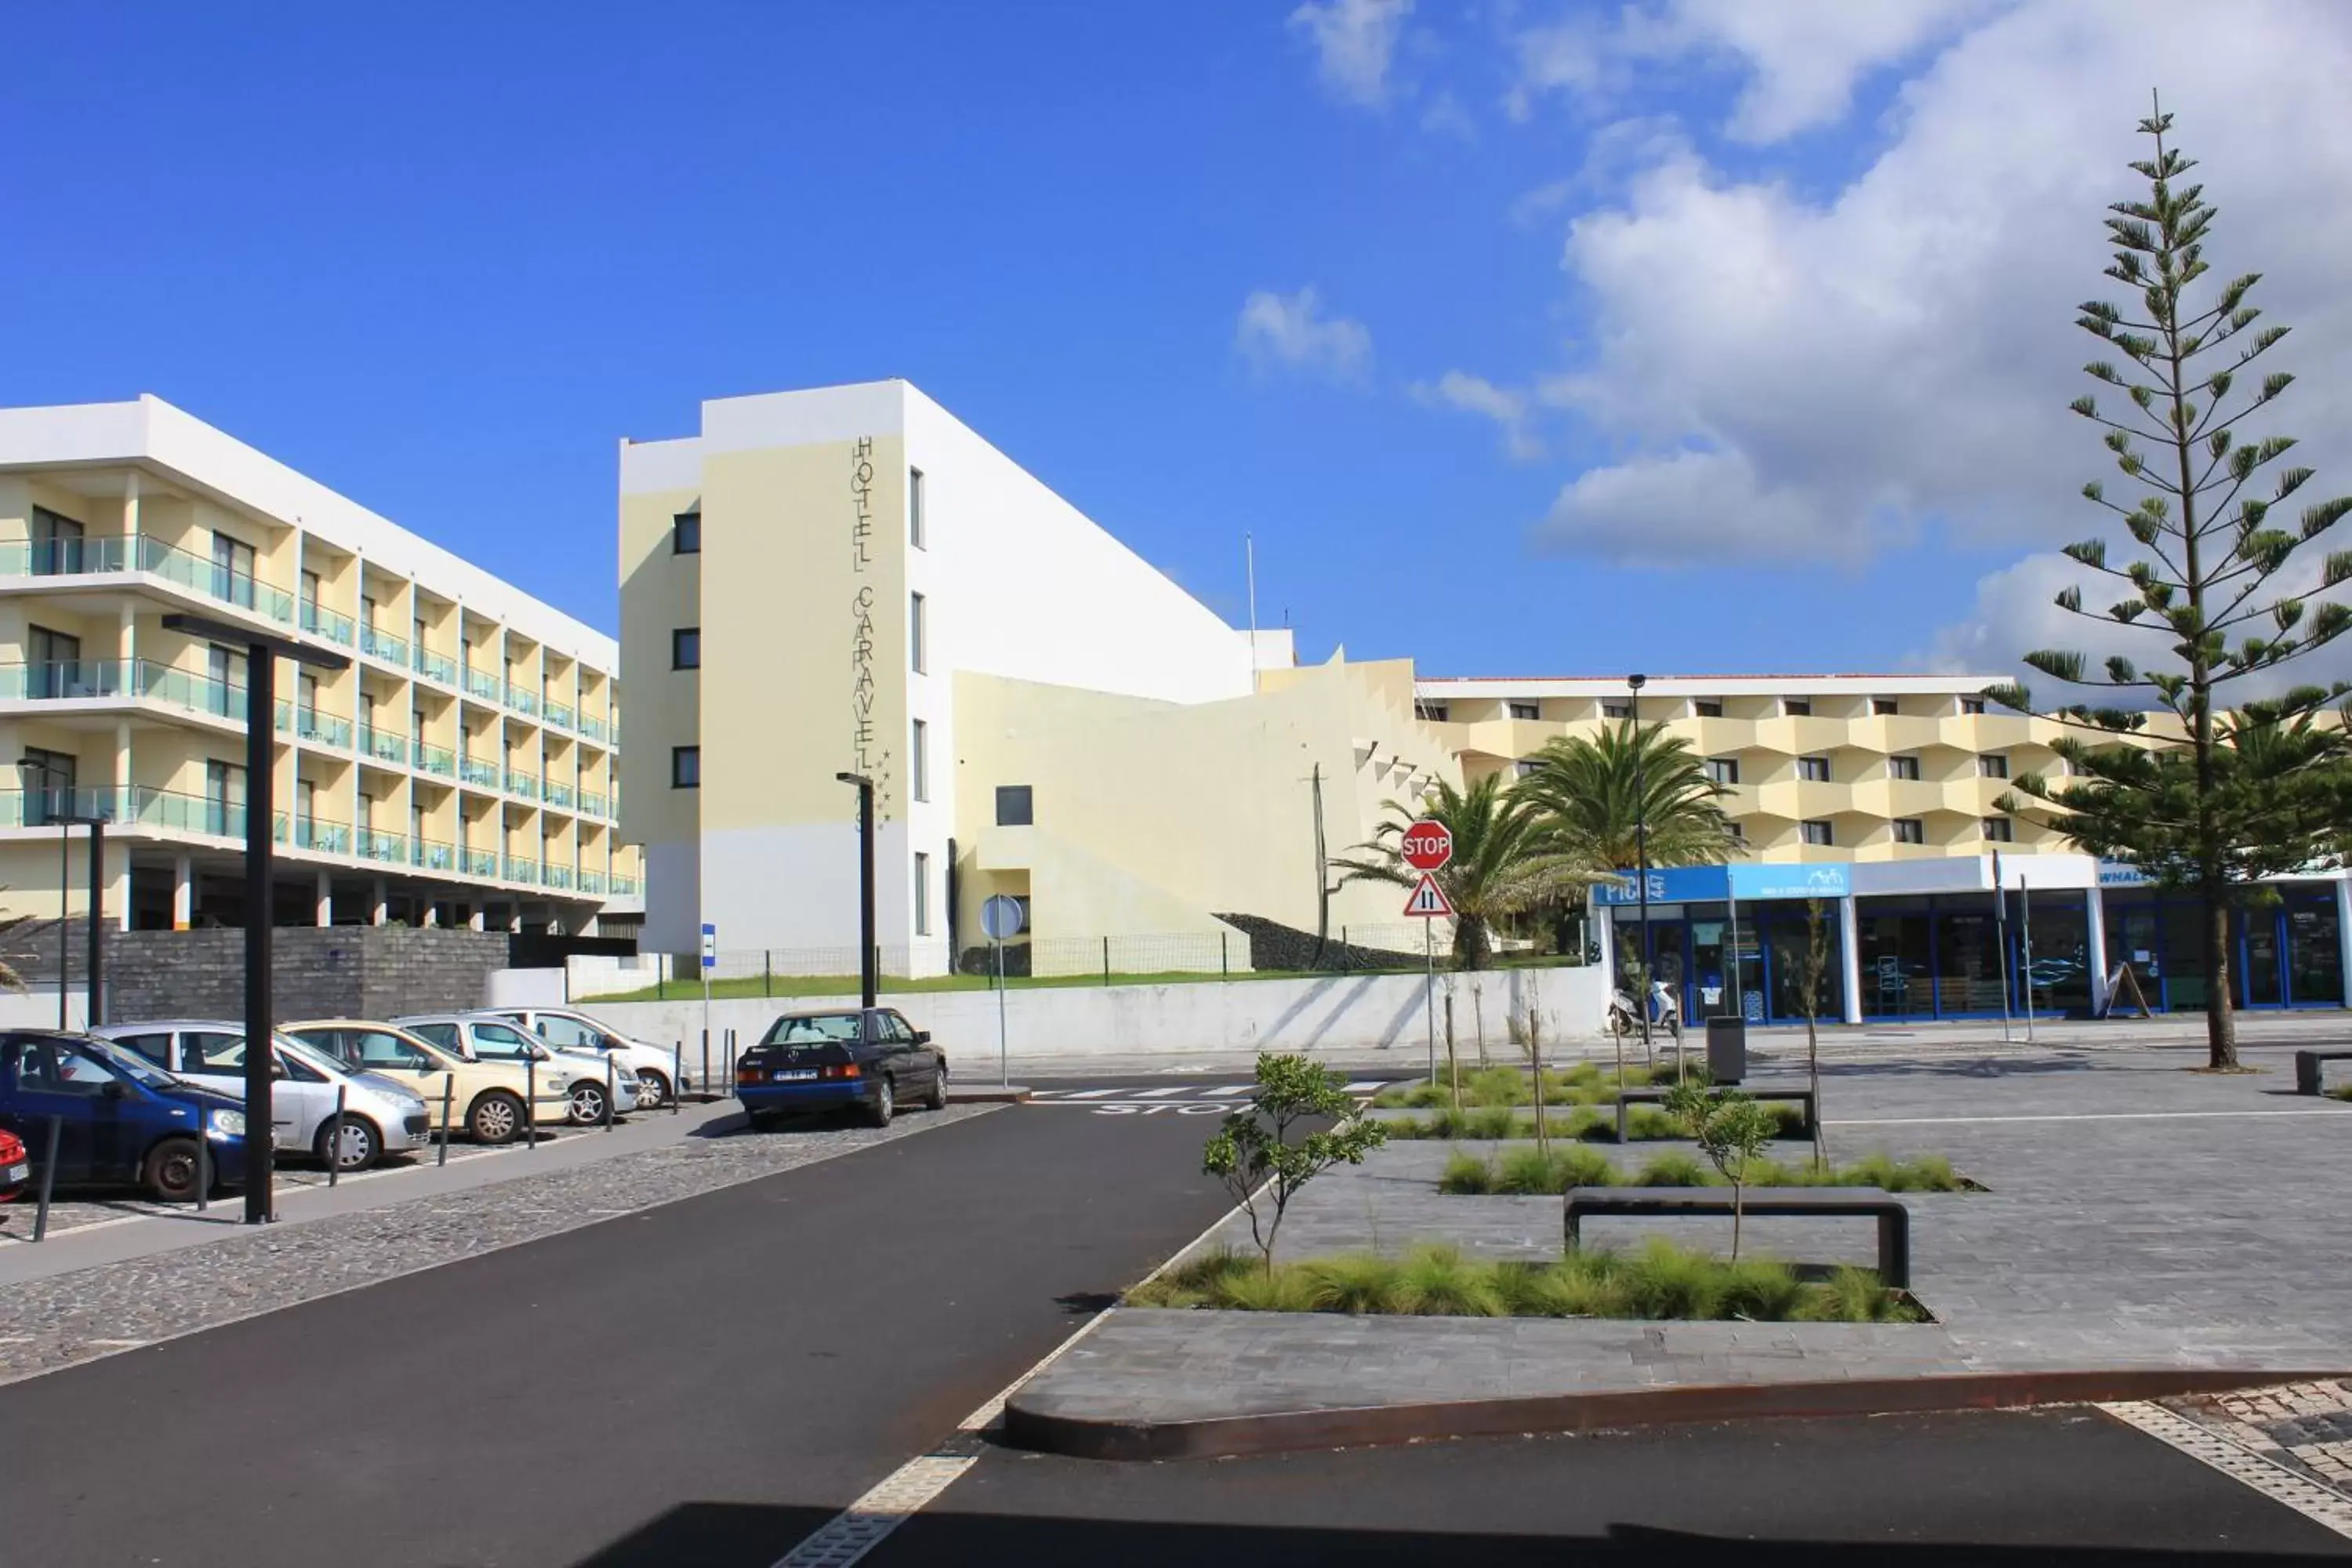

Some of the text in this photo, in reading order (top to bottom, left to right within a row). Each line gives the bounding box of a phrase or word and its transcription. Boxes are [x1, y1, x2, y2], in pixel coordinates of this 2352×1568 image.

[857, 435, 875, 790] HOTEL CARAVEL
[1403, 837, 1449, 856] STOP
